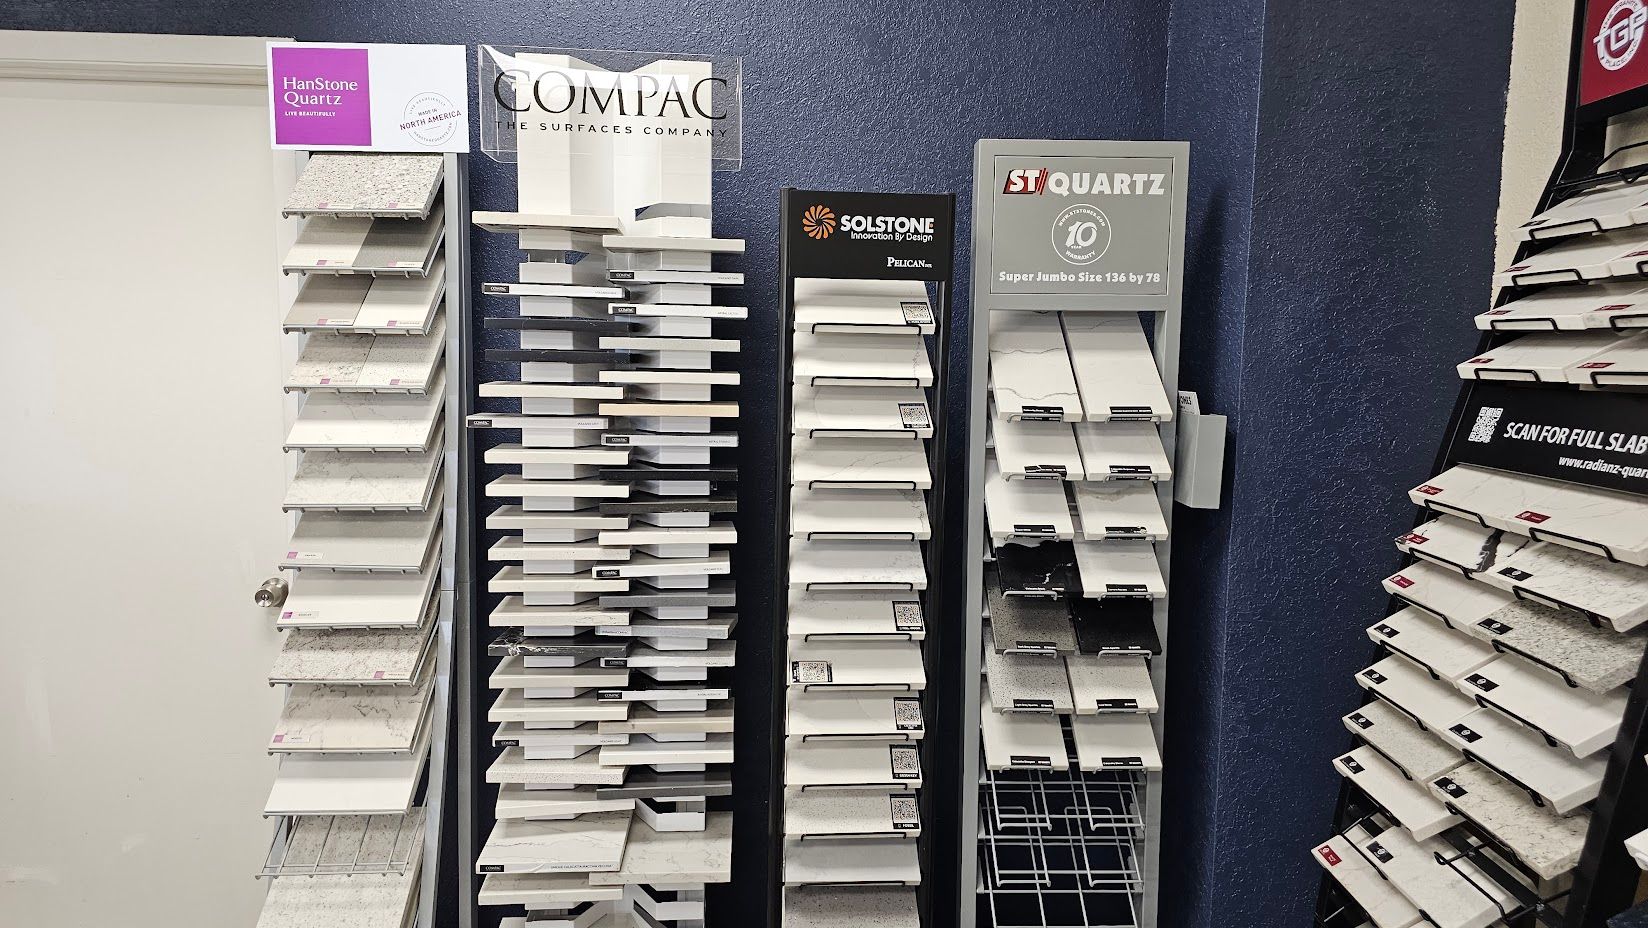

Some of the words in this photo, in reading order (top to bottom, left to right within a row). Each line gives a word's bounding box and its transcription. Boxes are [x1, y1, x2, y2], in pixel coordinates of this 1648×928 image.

[1592, 5, 1648, 51] TGP
[283, 76, 358, 91] HanStone
[284, 91, 342, 107] Quartz
[493, 69, 728, 120] COMPAC
[399, 118, 426, 131] NORTH
[427, 110, 462, 124] AMERICA
[495, 120, 528, 131] THE
[539, 122, 633, 135] SURFACES
[643, 126, 728, 137] COMPANY
[1048, 172, 1166, 197] QUARTZ
[840, 215, 934, 234] SOLSTONE
[1065, 221, 1098, 247] 10
[850, 231, 893, 241] Innovation
[895, 233, 905, 242] By
[906, 233, 933, 243] Design
[1065, 250, 1096, 260] WARRANTY
[999, 271, 1034, 284] Super
[1036, 271, 1076, 282] Jumbo
[1078, 271, 1103, 282] Size
[1105, 272, 1127, 283] 136
[1129, 272, 1144, 285] by
[1145, 272, 1161, 283] 78
[1503, 421, 1541, 441] SCAN
[1538, 425, 1570, 445] FOR
[1567, 428, 1605, 450] FULL
[1605, 432, 1648, 455] SLAB
